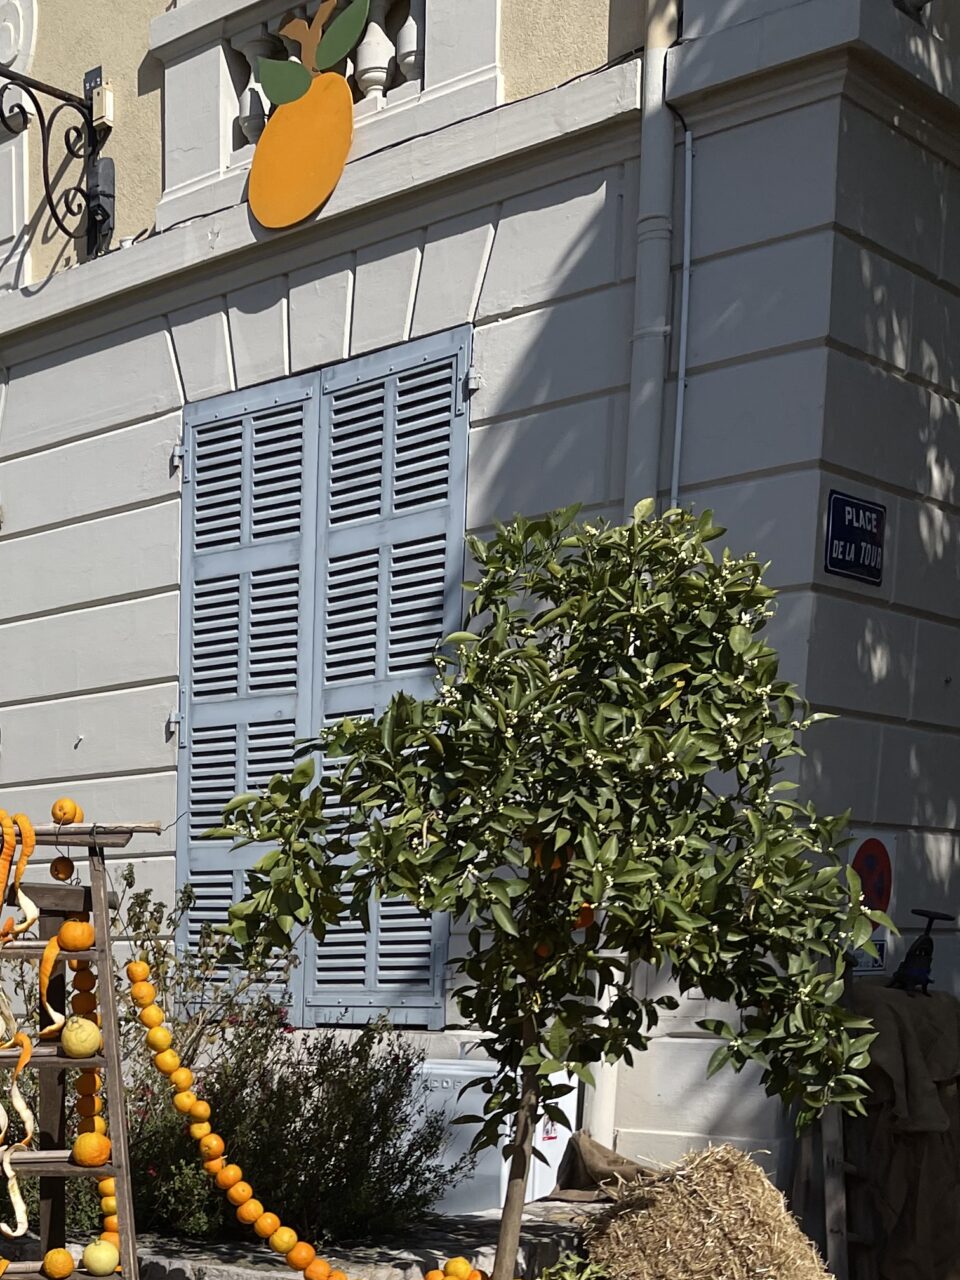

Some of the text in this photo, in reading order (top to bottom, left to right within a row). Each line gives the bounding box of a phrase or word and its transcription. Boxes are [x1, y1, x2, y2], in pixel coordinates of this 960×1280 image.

[845, 506, 878, 533] PLACE
[832, 539, 881, 569] DE LA TOUR
